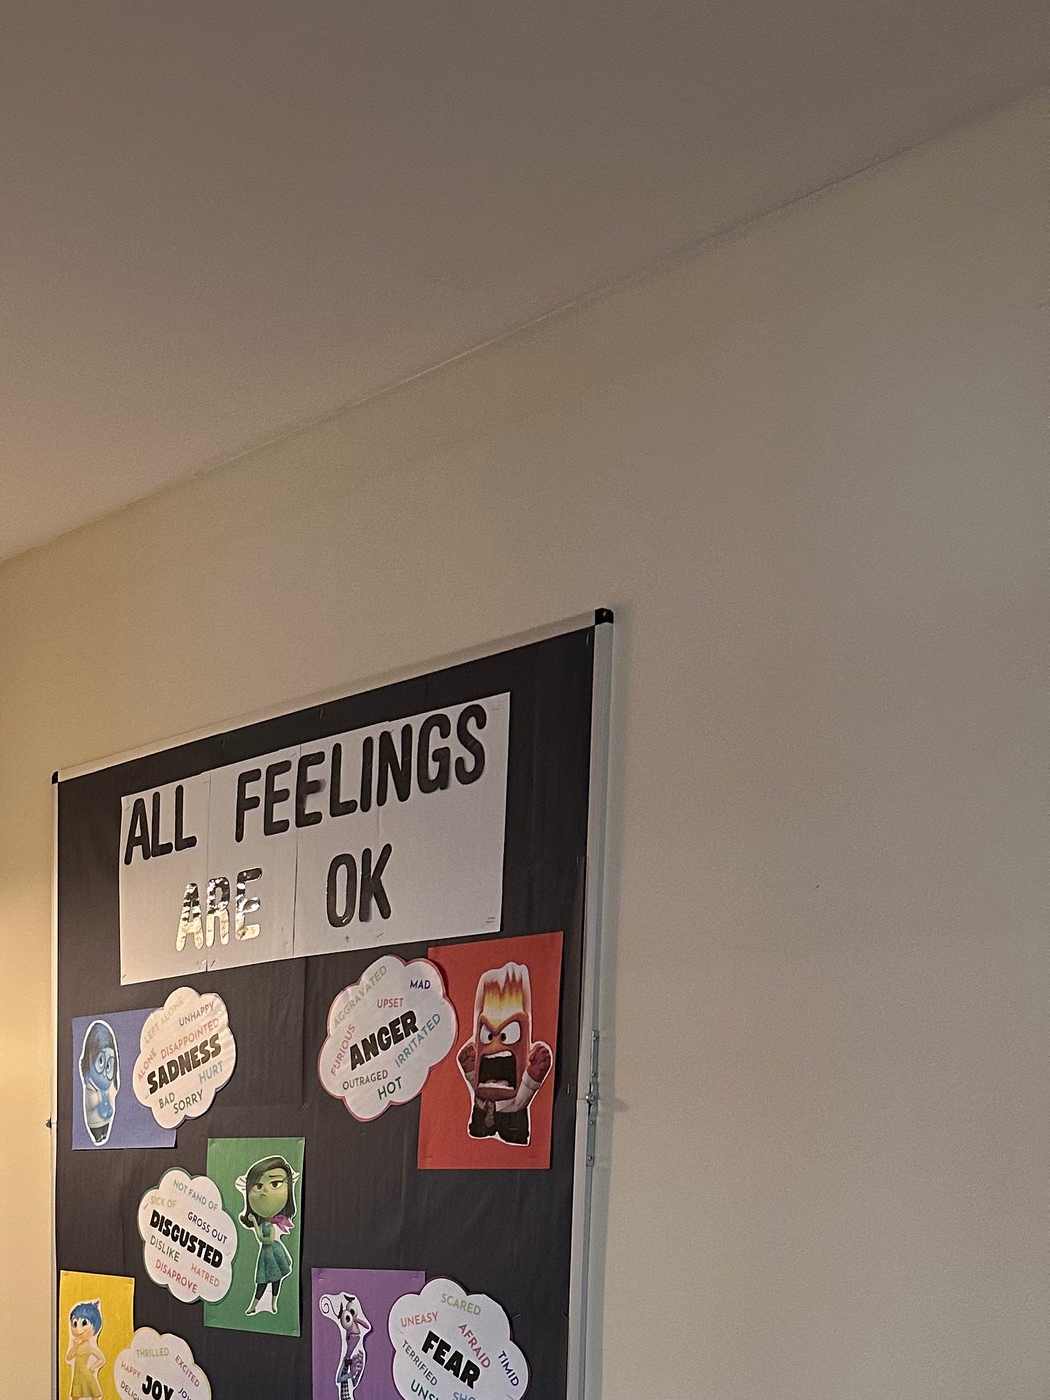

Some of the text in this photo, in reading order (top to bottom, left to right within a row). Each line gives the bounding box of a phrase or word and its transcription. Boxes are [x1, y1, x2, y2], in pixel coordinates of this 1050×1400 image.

[124, 704, 487, 866] ALL FEELINGS
[176, 843, 392, 952] ARE OK
[334, 965, 387, 1028] AGGRAVATED
[409, 980, 431, 990] MAD
[178, 1001, 215, 1027] UNHAPPY
[377, 998, 404, 1008] UPSET
[144, 996, 184, 1044] LEFT ALONE
[160, 1018, 219, 1059] DISAPPOINTED
[331, 1024, 356, 1076] FURIOUS
[351, 1010, 419, 1071] ANGER
[395, 1013, 440, 1068] IRRITATED
[138, 1047, 157, 1080] ALONE
[147, 1033, 222, 1095] SADNESS
[199, 1061, 223, 1085] HURT
[342, 1069, 388, 1090] OUTRAGED
[159, 1092, 175, 1109] BAD
[173, 1089, 203, 1114] SORRY
[378, 1076, 403, 1100] HOT
[150, 1196, 177, 1209] SICK OF
[173, 1180, 188, 1195] NOT
[208, 1200, 219, 1212] OF
[150, 1209, 223, 1269] DISGUSTED
[187, 1211, 228, 1245] GROSS OUT
[150, 1235, 181, 1262] DISLIKE
[155, 1259, 198, 1294] DISAPROVE
[190, 1263, 220, 1287] HATRED
[400, 1311, 439, 1327] UNEASY
[441, 1293, 481, 1316] SCARED
[136, 1347, 169, 1358] THRILLED
[421, 1330, 480, 1390] FEAR
[458, 1323, 490, 1368] AFRAID
[121, 1362, 141, 1379] HAPPY
[175, 1354, 200, 1387] EXCITED
[402, 1340, 438, 1386] TERRIFIED
[497, 1350, 519, 1387] TIMID
